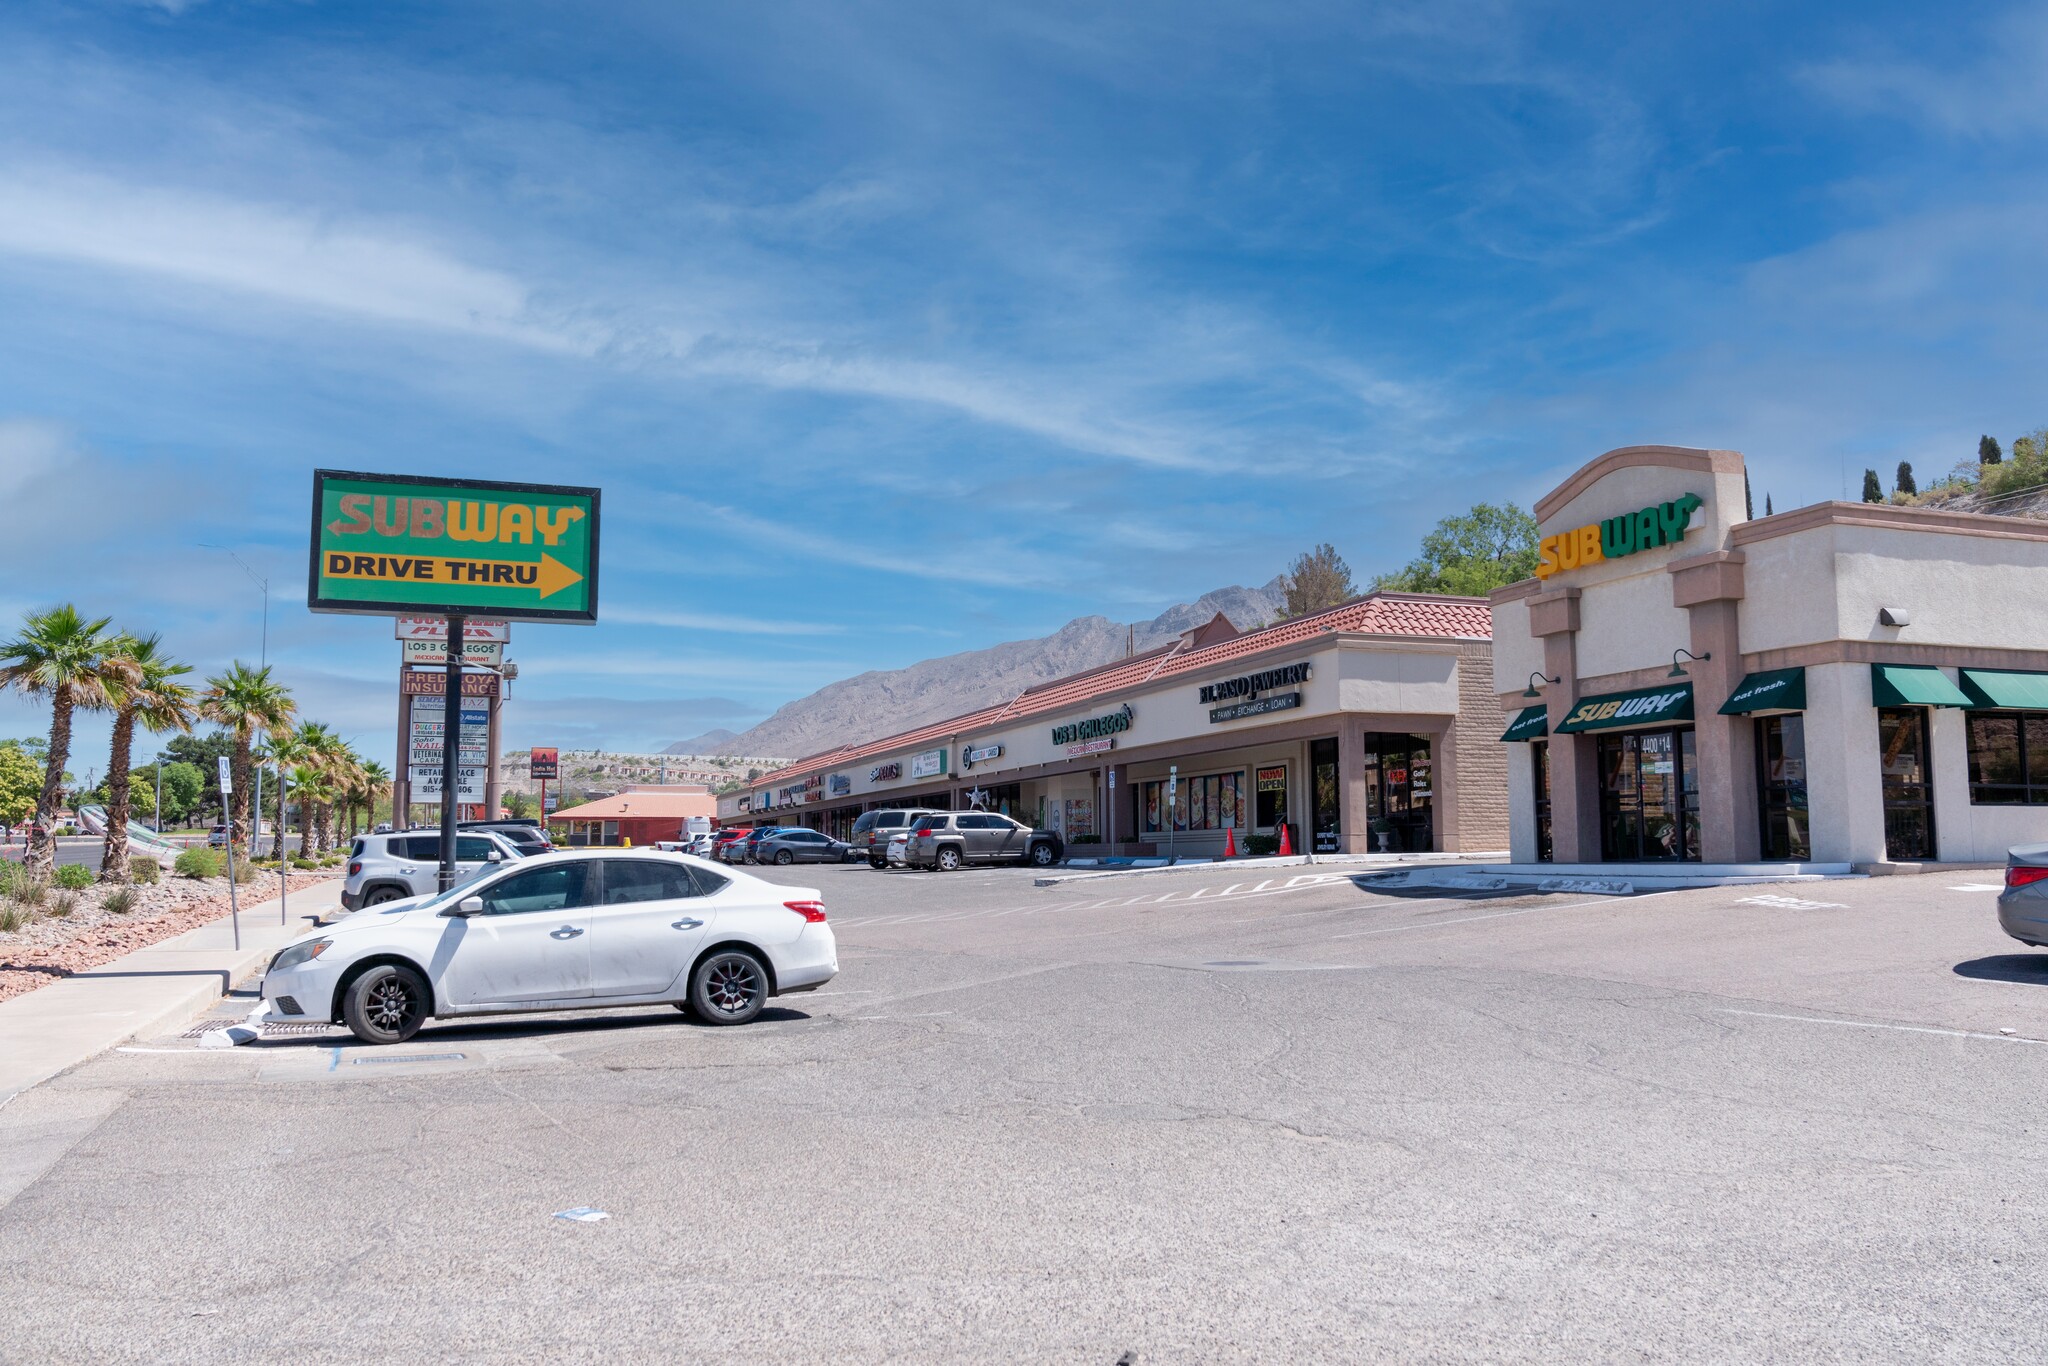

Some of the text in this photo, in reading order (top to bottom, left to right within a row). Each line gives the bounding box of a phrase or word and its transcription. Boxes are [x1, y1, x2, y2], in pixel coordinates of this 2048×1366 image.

[326, 494, 586, 546] SUBWAY
[1534, 492, 1702, 580] SUBWAY
[329, 555, 537, 584] DRIVE THRU
[411, 626, 494, 637] PLZA
[408, 643, 427, 651] LOS
[406, 672, 497, 684] FRED OYA
[1215, 677, 1250, 701] PASO
[1248, 662, 1310, 700] JEWELRY
[406, 683, 498, 694] INSUNCE
[1734, 690, 1752, 701] eat
[1217, 698, 1286, 719] PAWN EXCHANGE LOAN
[1567, 690, 1687, 725] SUBWAY
[1052, 726, 1070, 745] LOS
[1078, 712, 1129, 740] GALLEGOS
[1512, 721, 1526, 731] eat
[1642, 738, 1658, 753] 4400
[1260, 768, 1284, 780] NOW
[1259, 779, 1284, 790] OPEN
